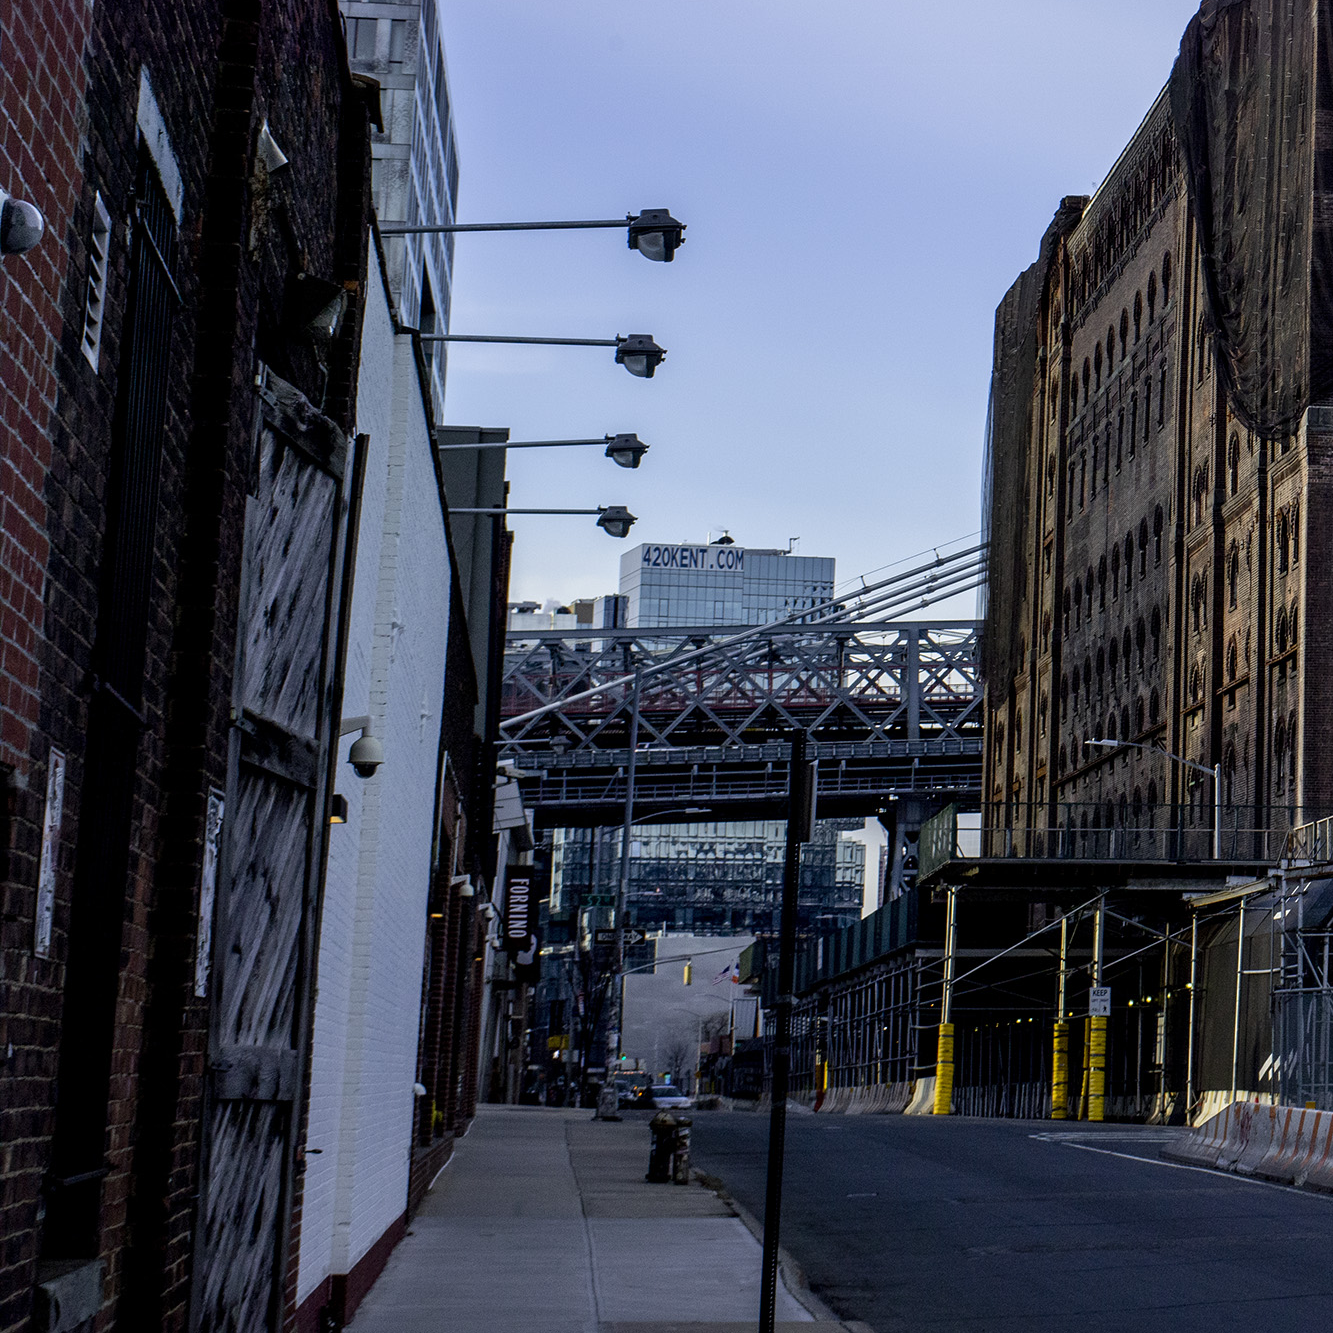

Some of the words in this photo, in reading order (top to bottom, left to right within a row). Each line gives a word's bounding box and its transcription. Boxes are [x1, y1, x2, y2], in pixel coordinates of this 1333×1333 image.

[643, 546, 744, 571] 420KENT.COM
[508, 877, 531, 940] FORNINO
[1092, 989, 1108, 997] KEEP
